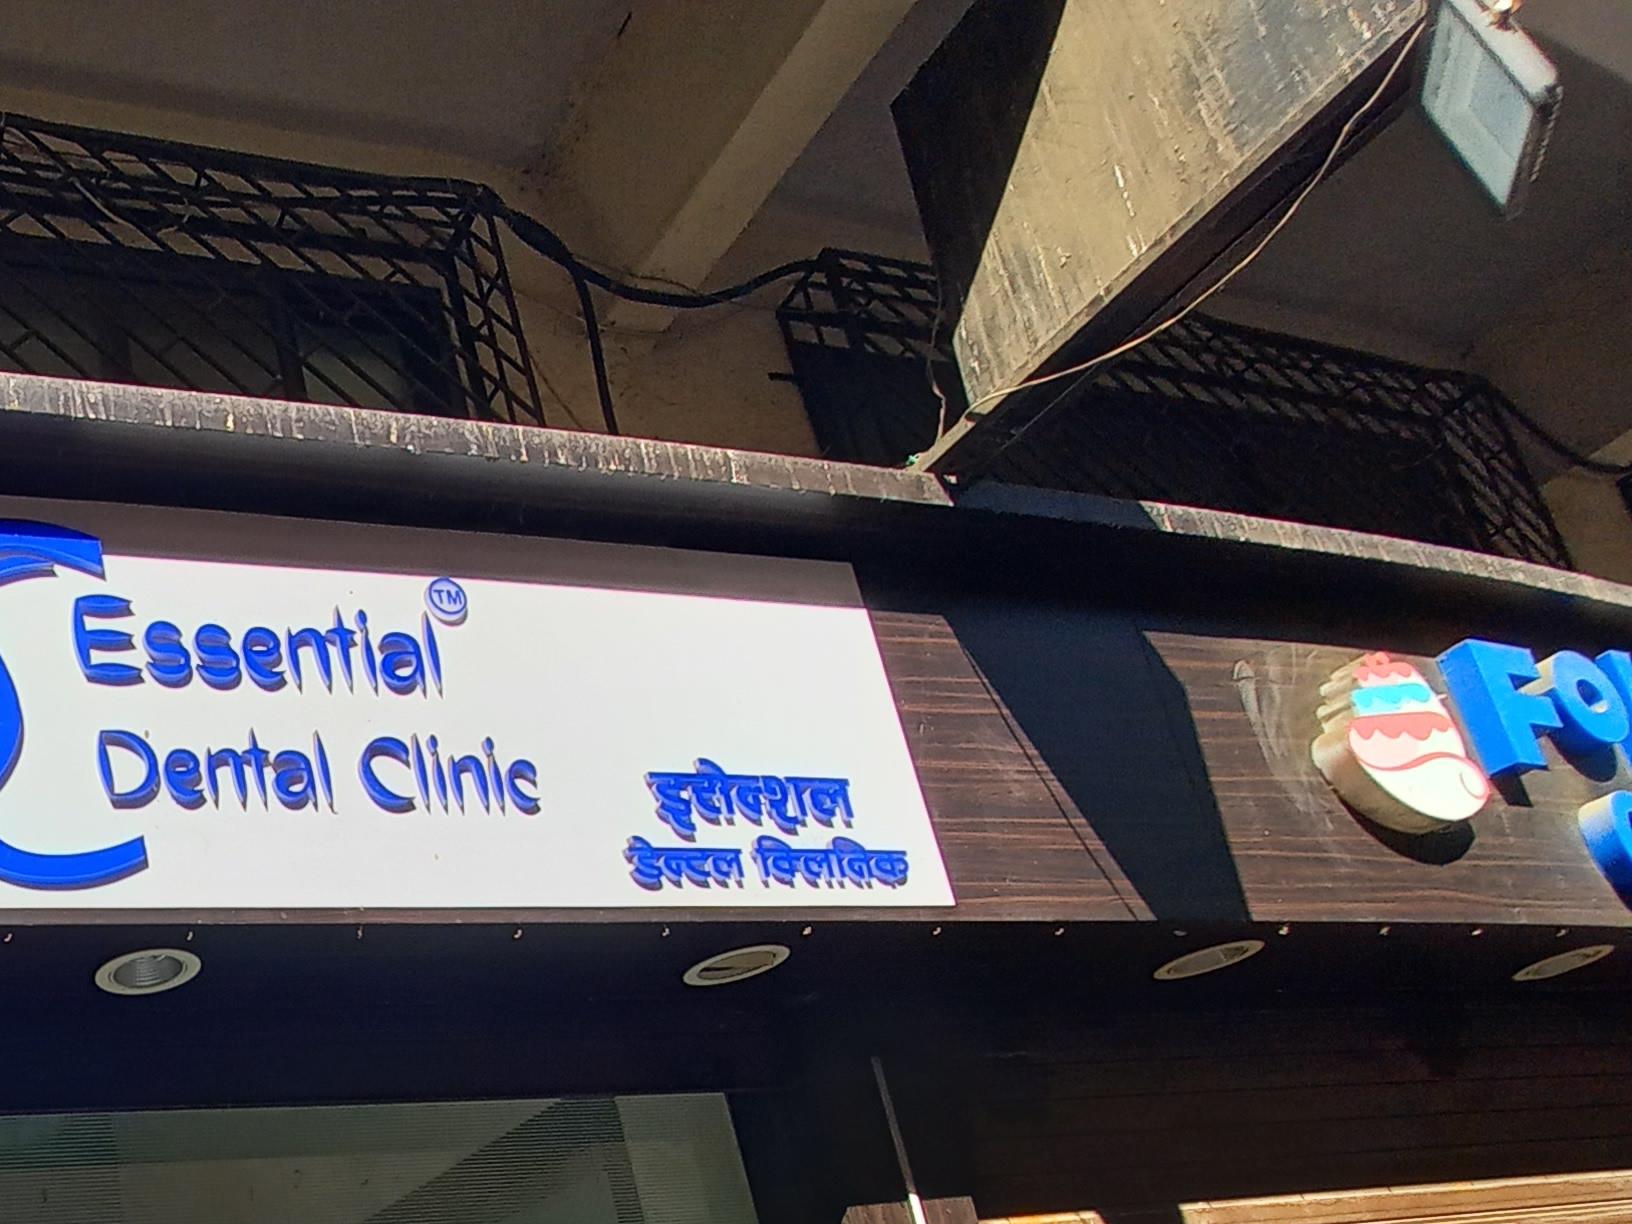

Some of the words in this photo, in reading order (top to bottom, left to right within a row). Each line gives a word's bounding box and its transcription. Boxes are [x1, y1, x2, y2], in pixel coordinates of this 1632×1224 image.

[72, 594, 444, 699] Essential
[97, 727, 337, 814] Dental
[358, 733, 542, 816] Clinic
